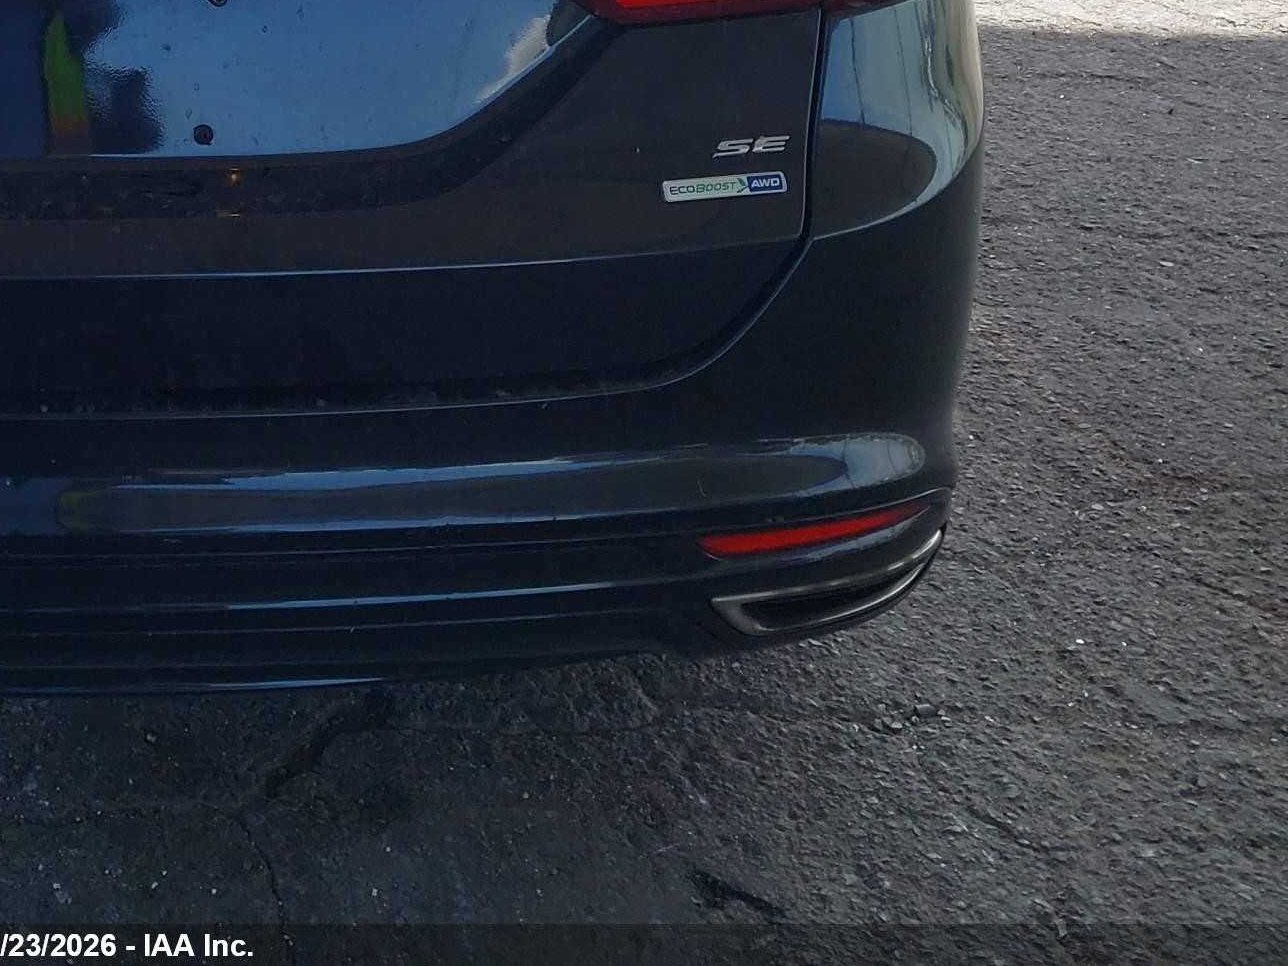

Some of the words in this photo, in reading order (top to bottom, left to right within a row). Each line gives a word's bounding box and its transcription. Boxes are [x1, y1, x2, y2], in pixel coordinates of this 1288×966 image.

[712, 135, 790, 159] SE
[669, 180, 737, 195] ECOBOOST
[750, 177, 780, 189] AWD
